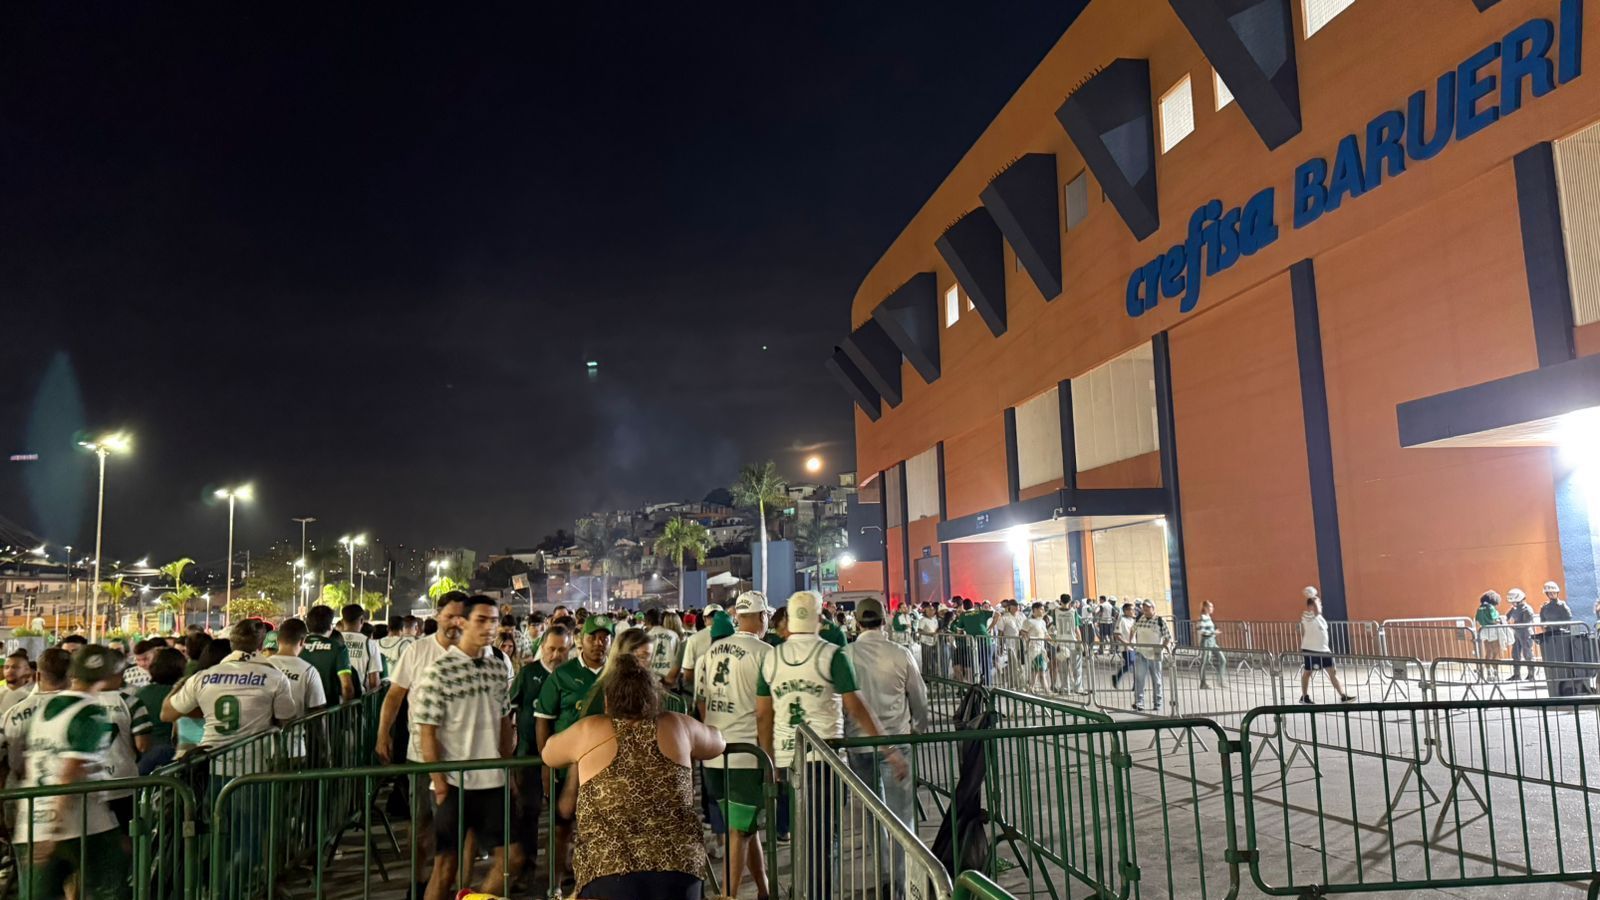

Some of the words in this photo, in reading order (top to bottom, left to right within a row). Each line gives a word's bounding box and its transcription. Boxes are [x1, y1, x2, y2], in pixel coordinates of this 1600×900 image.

[1126, 187, 1278, 317] crefisa
[1294, 0, 1583, 229] BARUERI
[710, 643, 746, 661] MANCHA
[201, 671, 268, 689] parmalat
[214, 694, 241, 736] 9
